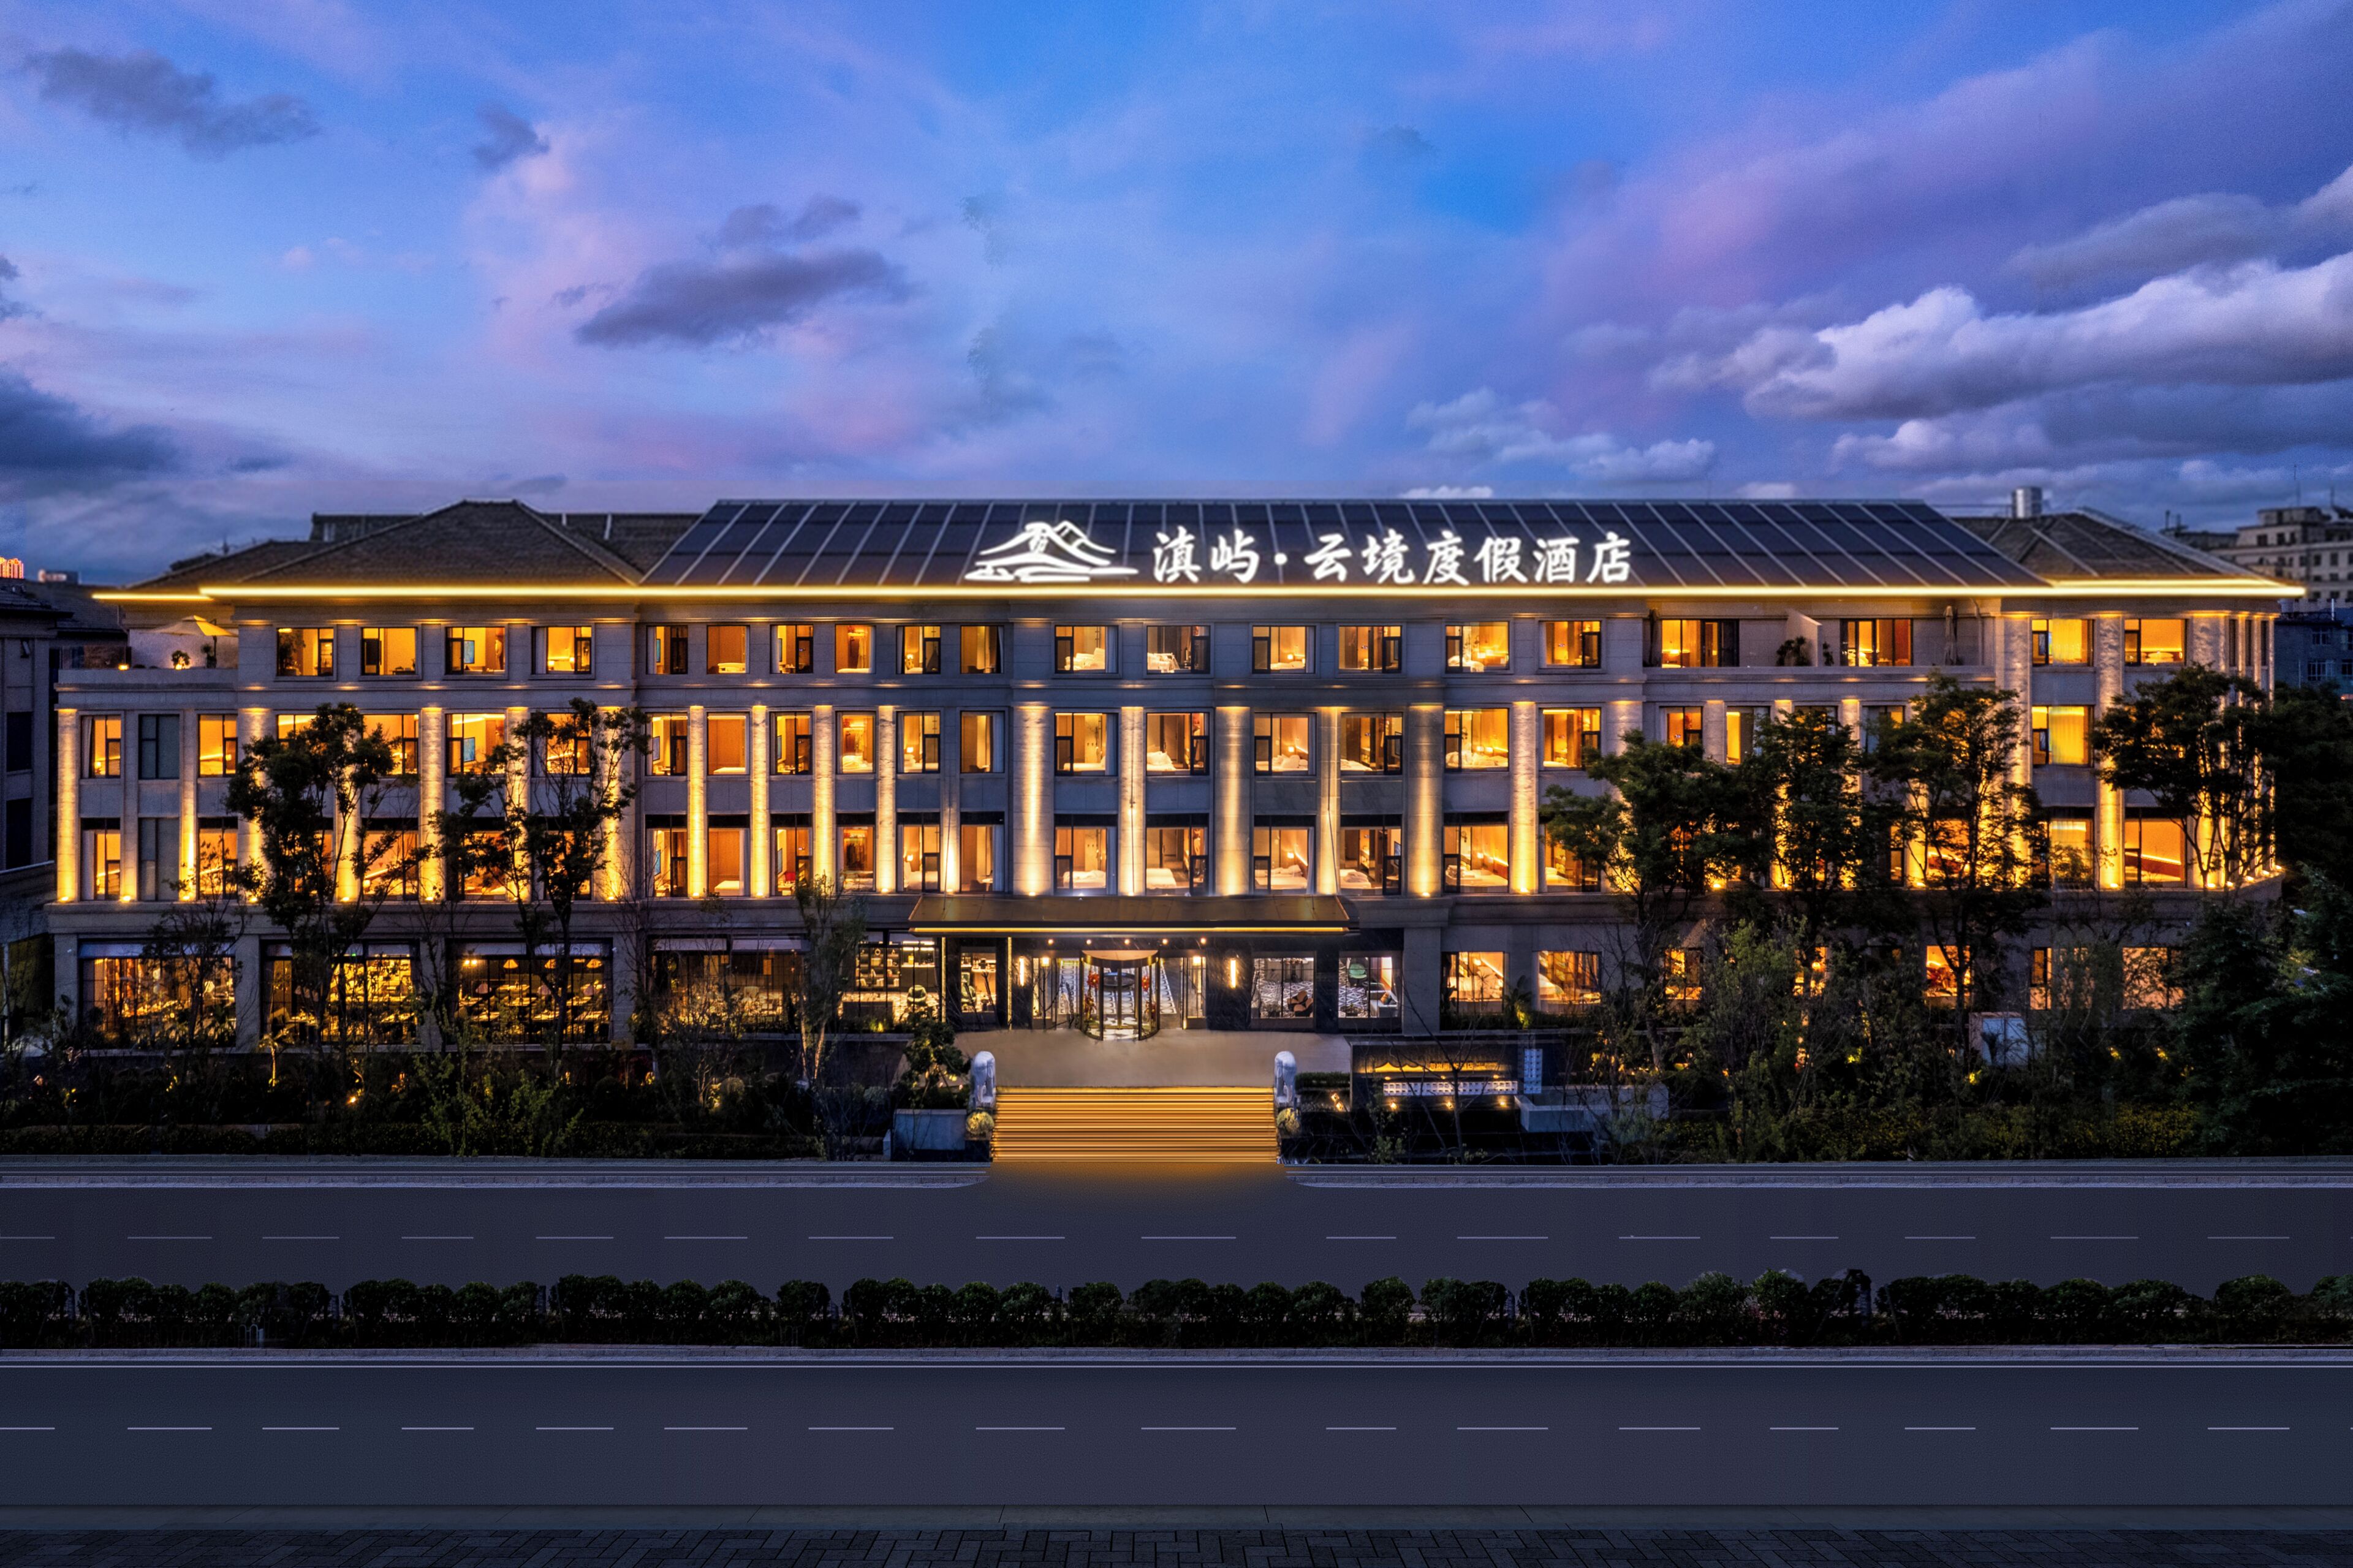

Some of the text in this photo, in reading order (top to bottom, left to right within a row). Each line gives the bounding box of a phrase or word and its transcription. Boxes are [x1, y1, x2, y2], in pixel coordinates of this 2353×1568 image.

[1153, 525, 1632, 585] 滇屿·云境度假酒店
